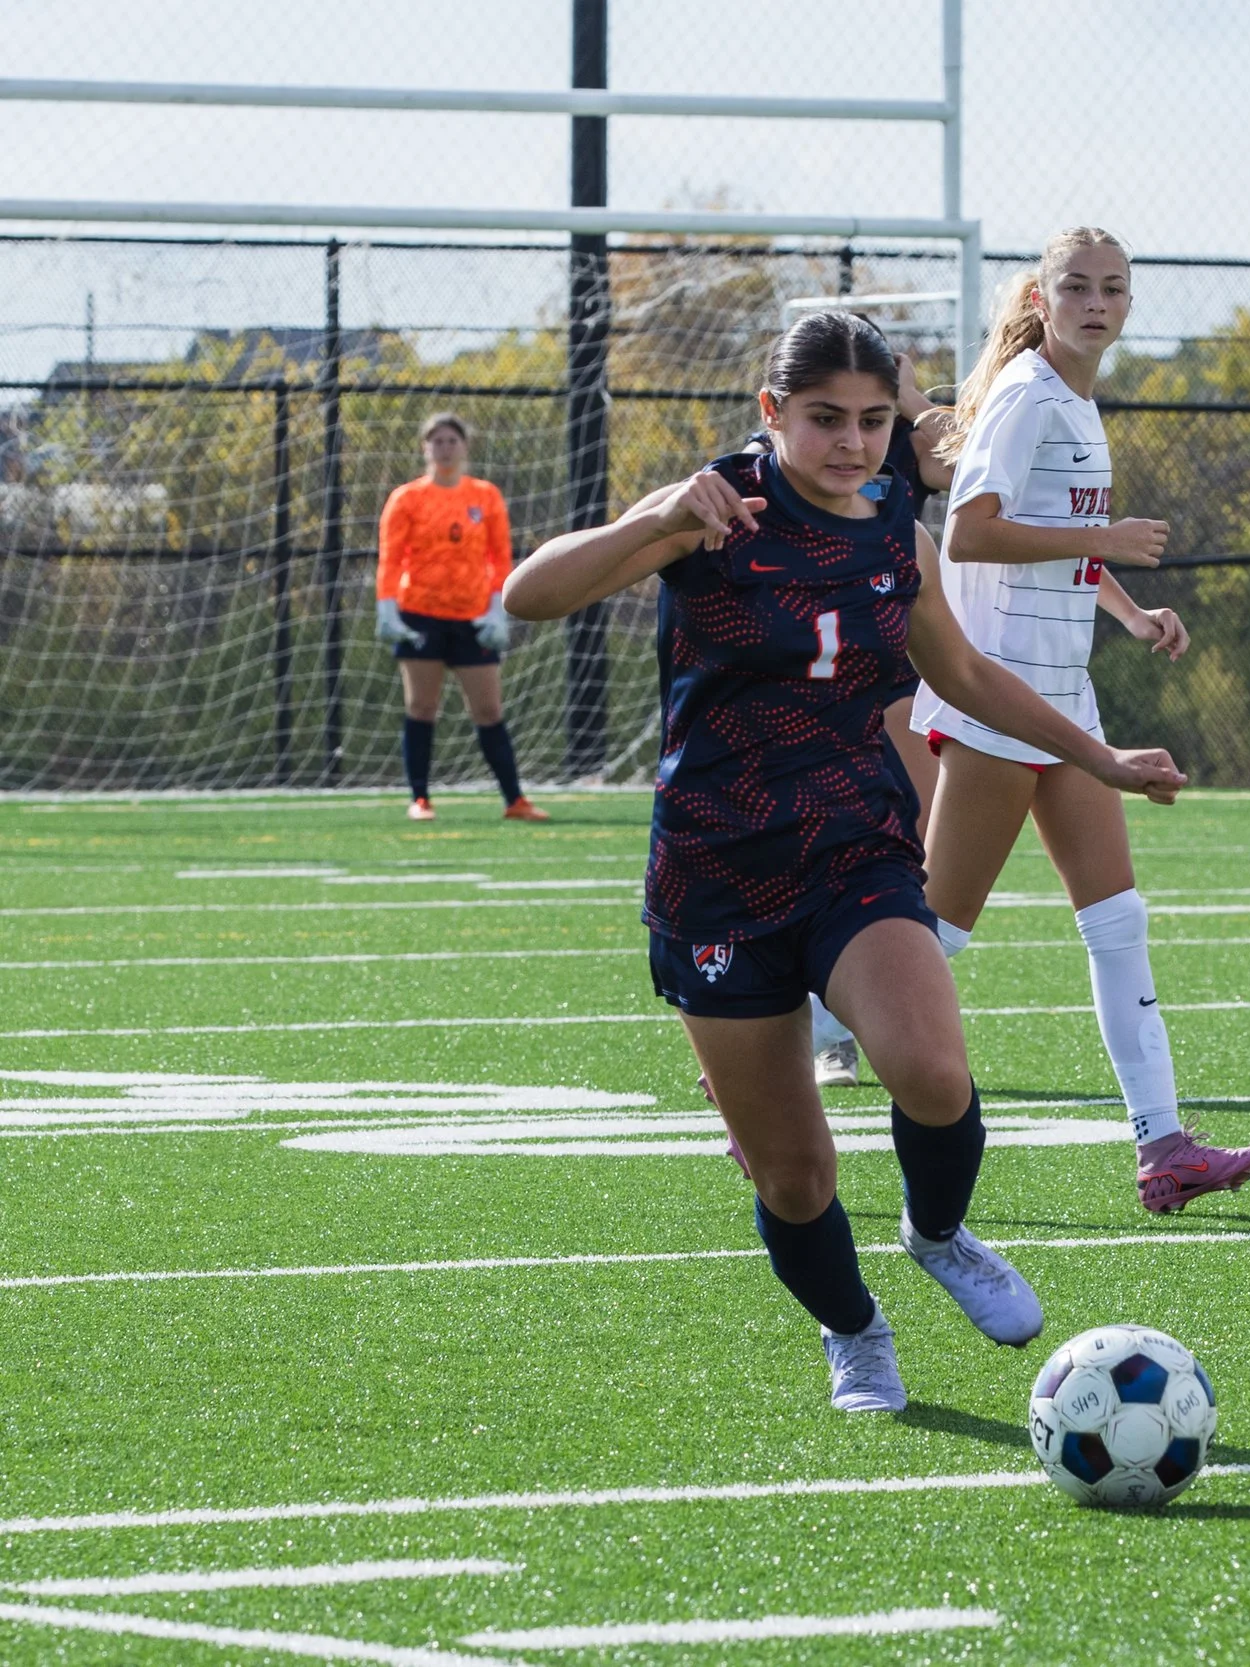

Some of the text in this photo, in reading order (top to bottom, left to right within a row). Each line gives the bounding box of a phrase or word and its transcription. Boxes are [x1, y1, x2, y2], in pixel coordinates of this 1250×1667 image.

[808, 608, 842, 680] 1
[714, 944, 726, 966] G
[1176, 1389, 1200, 1416] GHS
